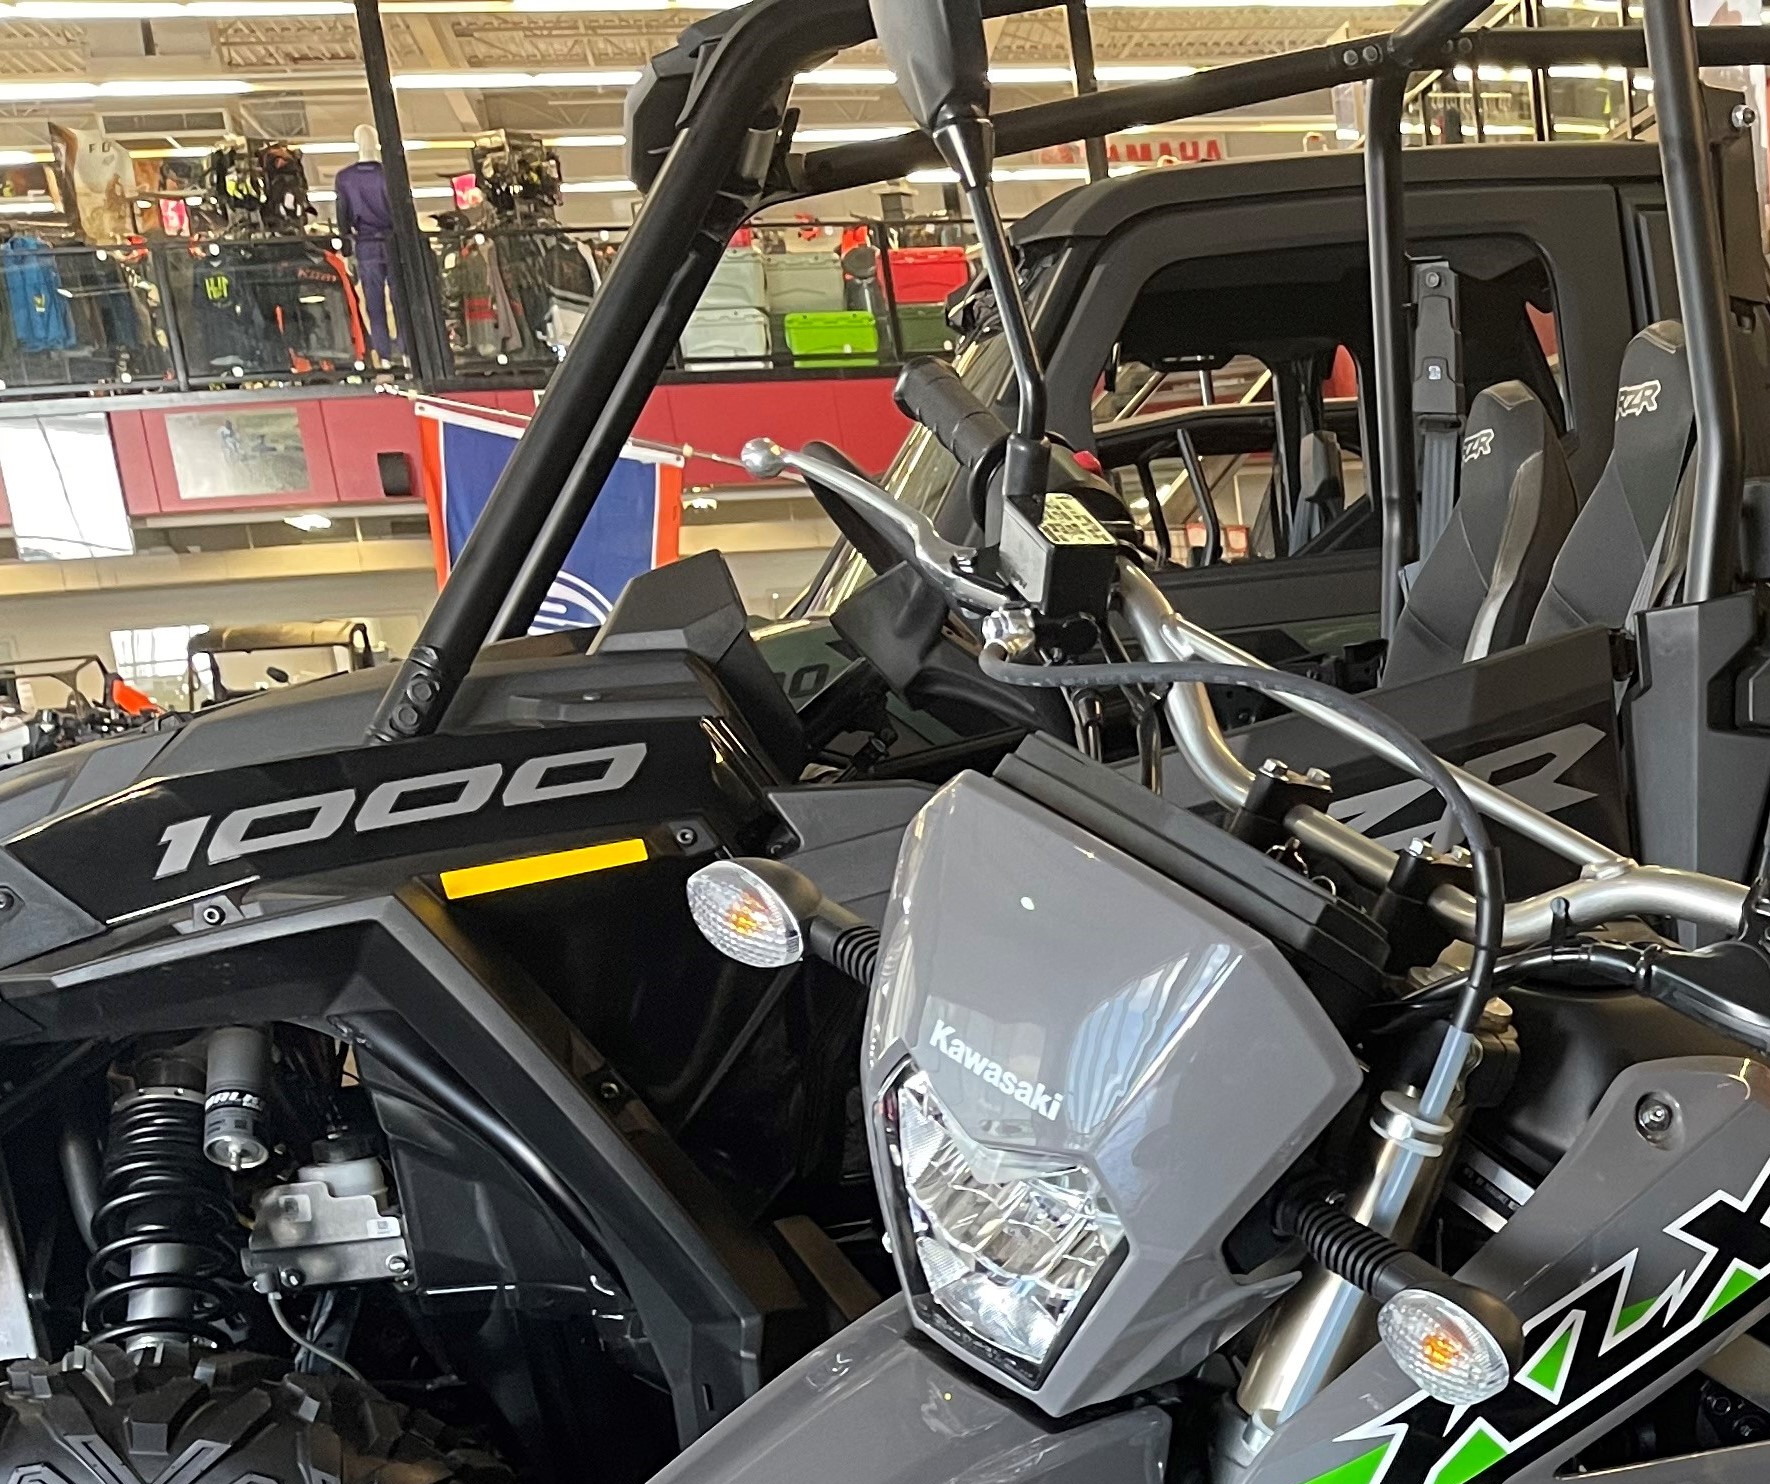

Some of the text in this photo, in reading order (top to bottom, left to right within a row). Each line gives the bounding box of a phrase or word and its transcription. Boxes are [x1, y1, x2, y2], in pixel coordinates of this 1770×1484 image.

[1080, 139, 1222, 162] AMAHA
[152, 743, 647, 880] 1000
[930, 1019, 1064, 1121] Kawasaki
